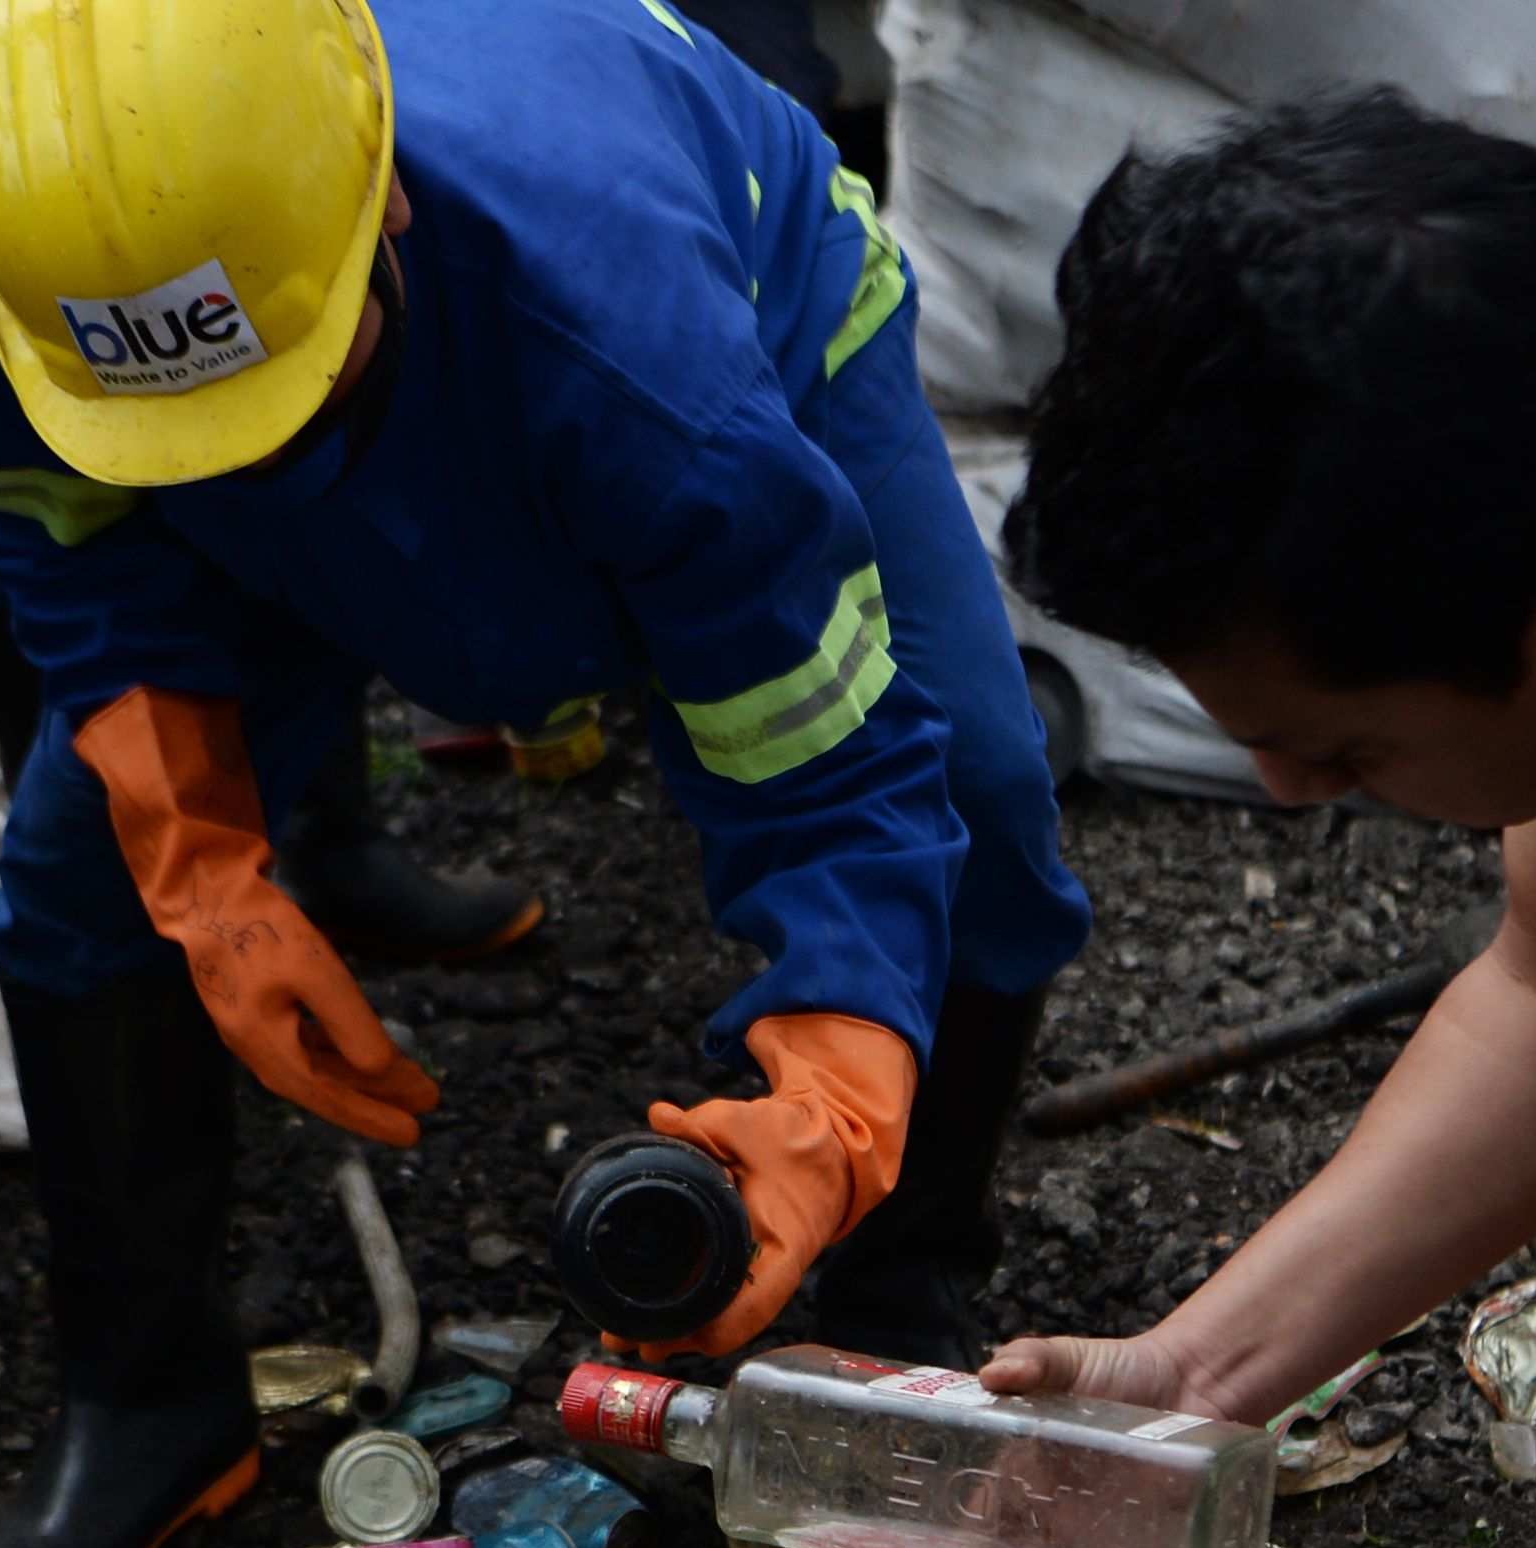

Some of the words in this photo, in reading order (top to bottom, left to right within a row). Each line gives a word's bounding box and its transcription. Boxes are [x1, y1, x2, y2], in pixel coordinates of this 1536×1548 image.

[61, 293, 241, 367] blue
[97, 368, 162, 386] Waste
[165, 367, 188, 381] to
[191, 343, 251, 373] Value
